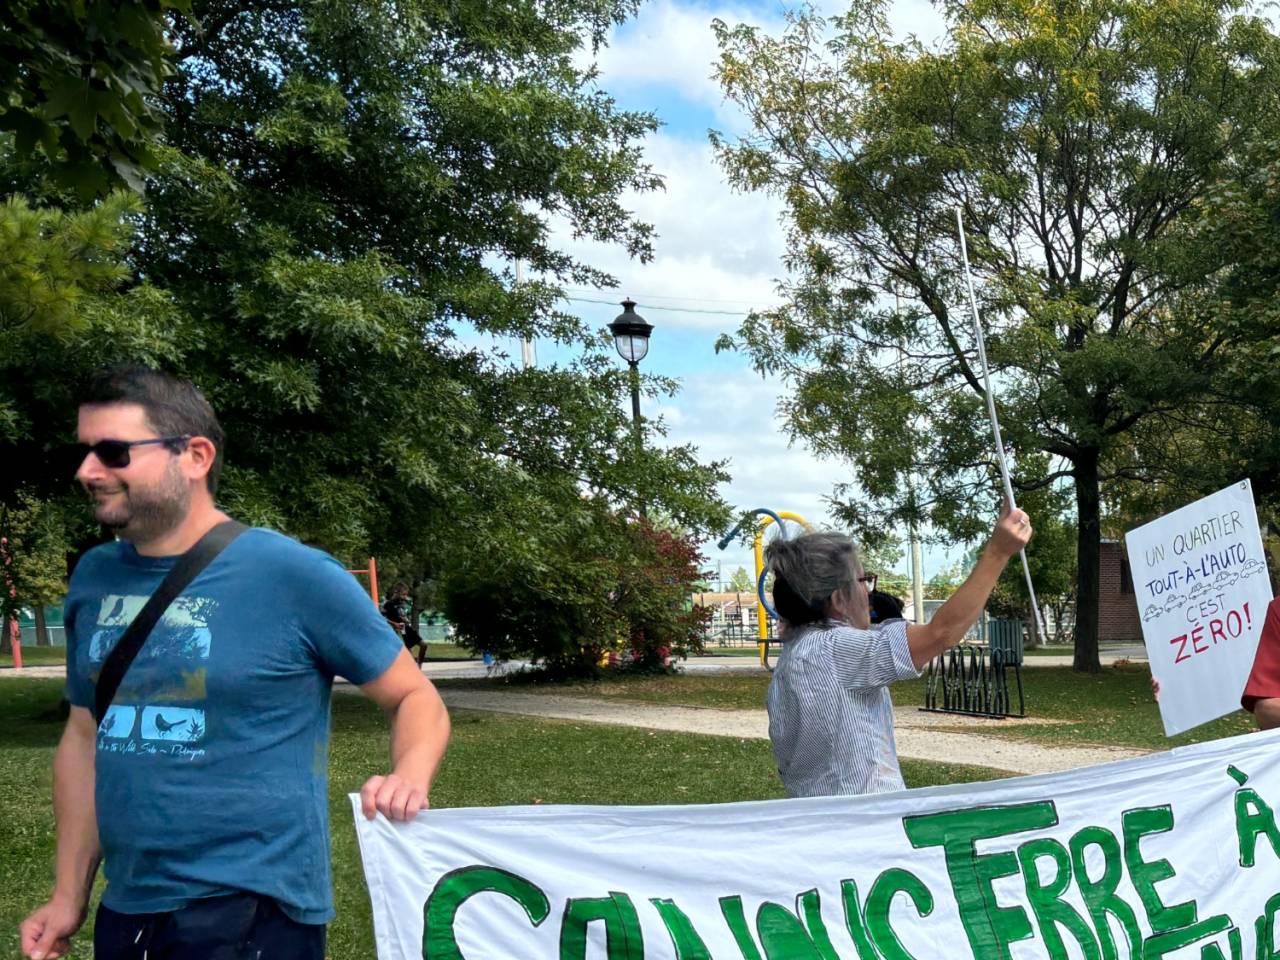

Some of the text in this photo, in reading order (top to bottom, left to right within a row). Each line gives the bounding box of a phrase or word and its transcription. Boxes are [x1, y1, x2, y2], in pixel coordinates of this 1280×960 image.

[1145, 510, 1244, 567] UN QUARTIER
[1145, 542, 1246, 597] TOUT-À-L'AUTO
[1169, 602, 1252, 664] ZÉRO!
[1186, 593, 1225, 623] C'EST
